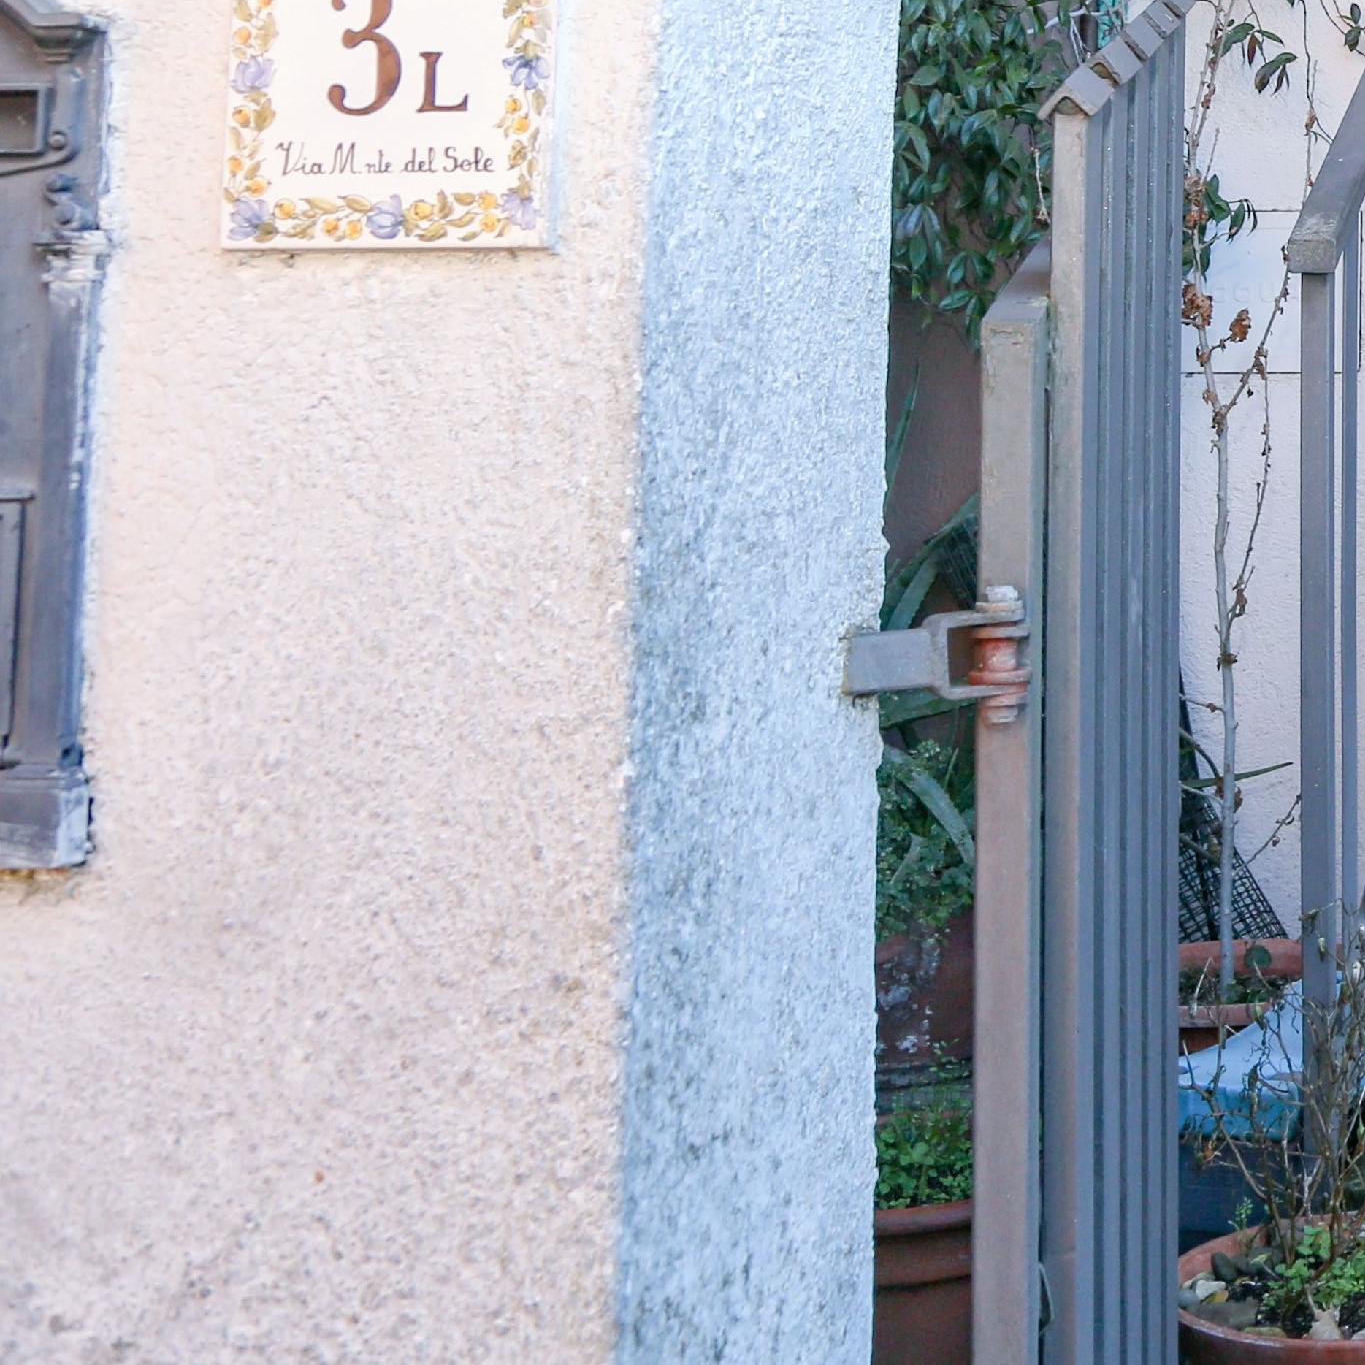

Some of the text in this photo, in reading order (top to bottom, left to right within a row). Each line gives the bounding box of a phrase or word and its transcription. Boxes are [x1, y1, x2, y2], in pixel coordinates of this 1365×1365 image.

[275, 141, 326, 176] Via
[400, 147, 438, 173] del
[442, 146, 495, 173] Sole
